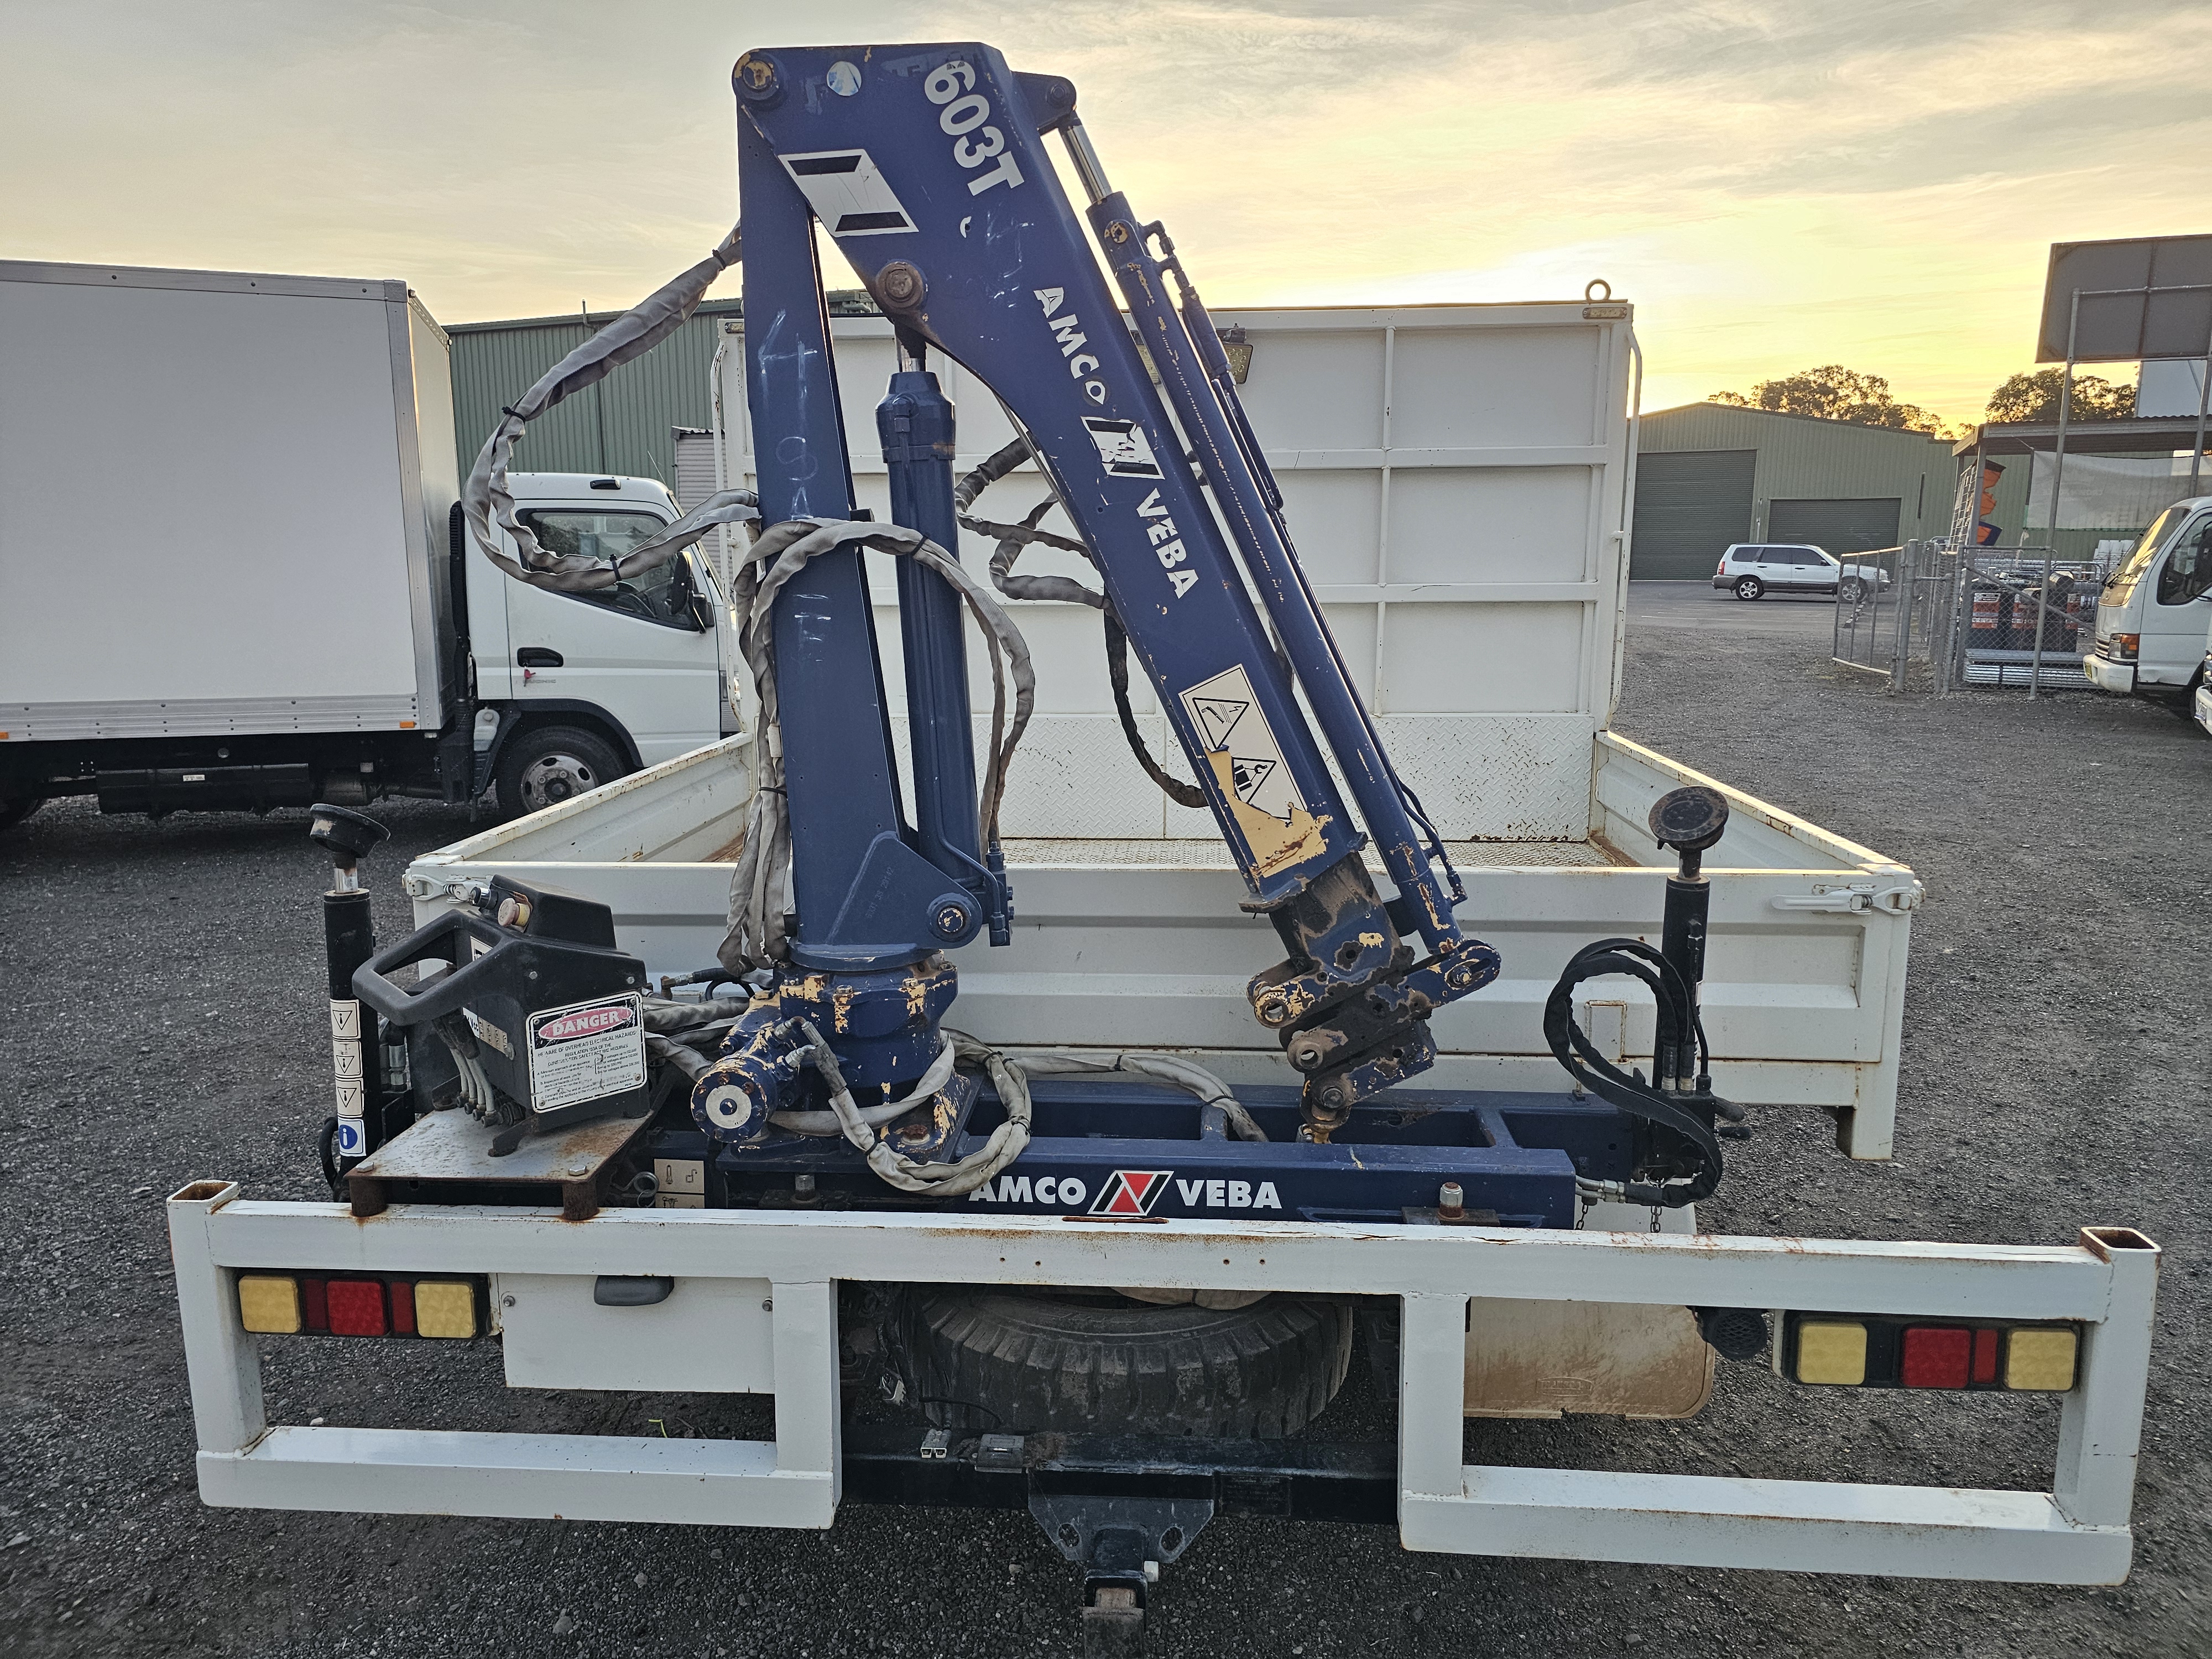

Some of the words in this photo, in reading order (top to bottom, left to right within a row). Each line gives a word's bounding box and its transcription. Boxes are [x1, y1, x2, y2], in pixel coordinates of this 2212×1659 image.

[925, 60, 1024, 196] 603T
[1034, 287, 1105, 404] AMCO
[1136, 487, 1199, 599] VEBA
[553, 1011, 619, 1036] DANGER
[565, 1041, 588, 1051] OVERHEAD
[589, 1035, 614, 1045] ELECTRICAL
[615, 1030, 635, 1039] HAZARDS
[565, 1048, 588, 1057] REGULATION
[969, 1177, 1086, 1206] AMCO
[1176, 1179, 1282, 1209] VEBA
